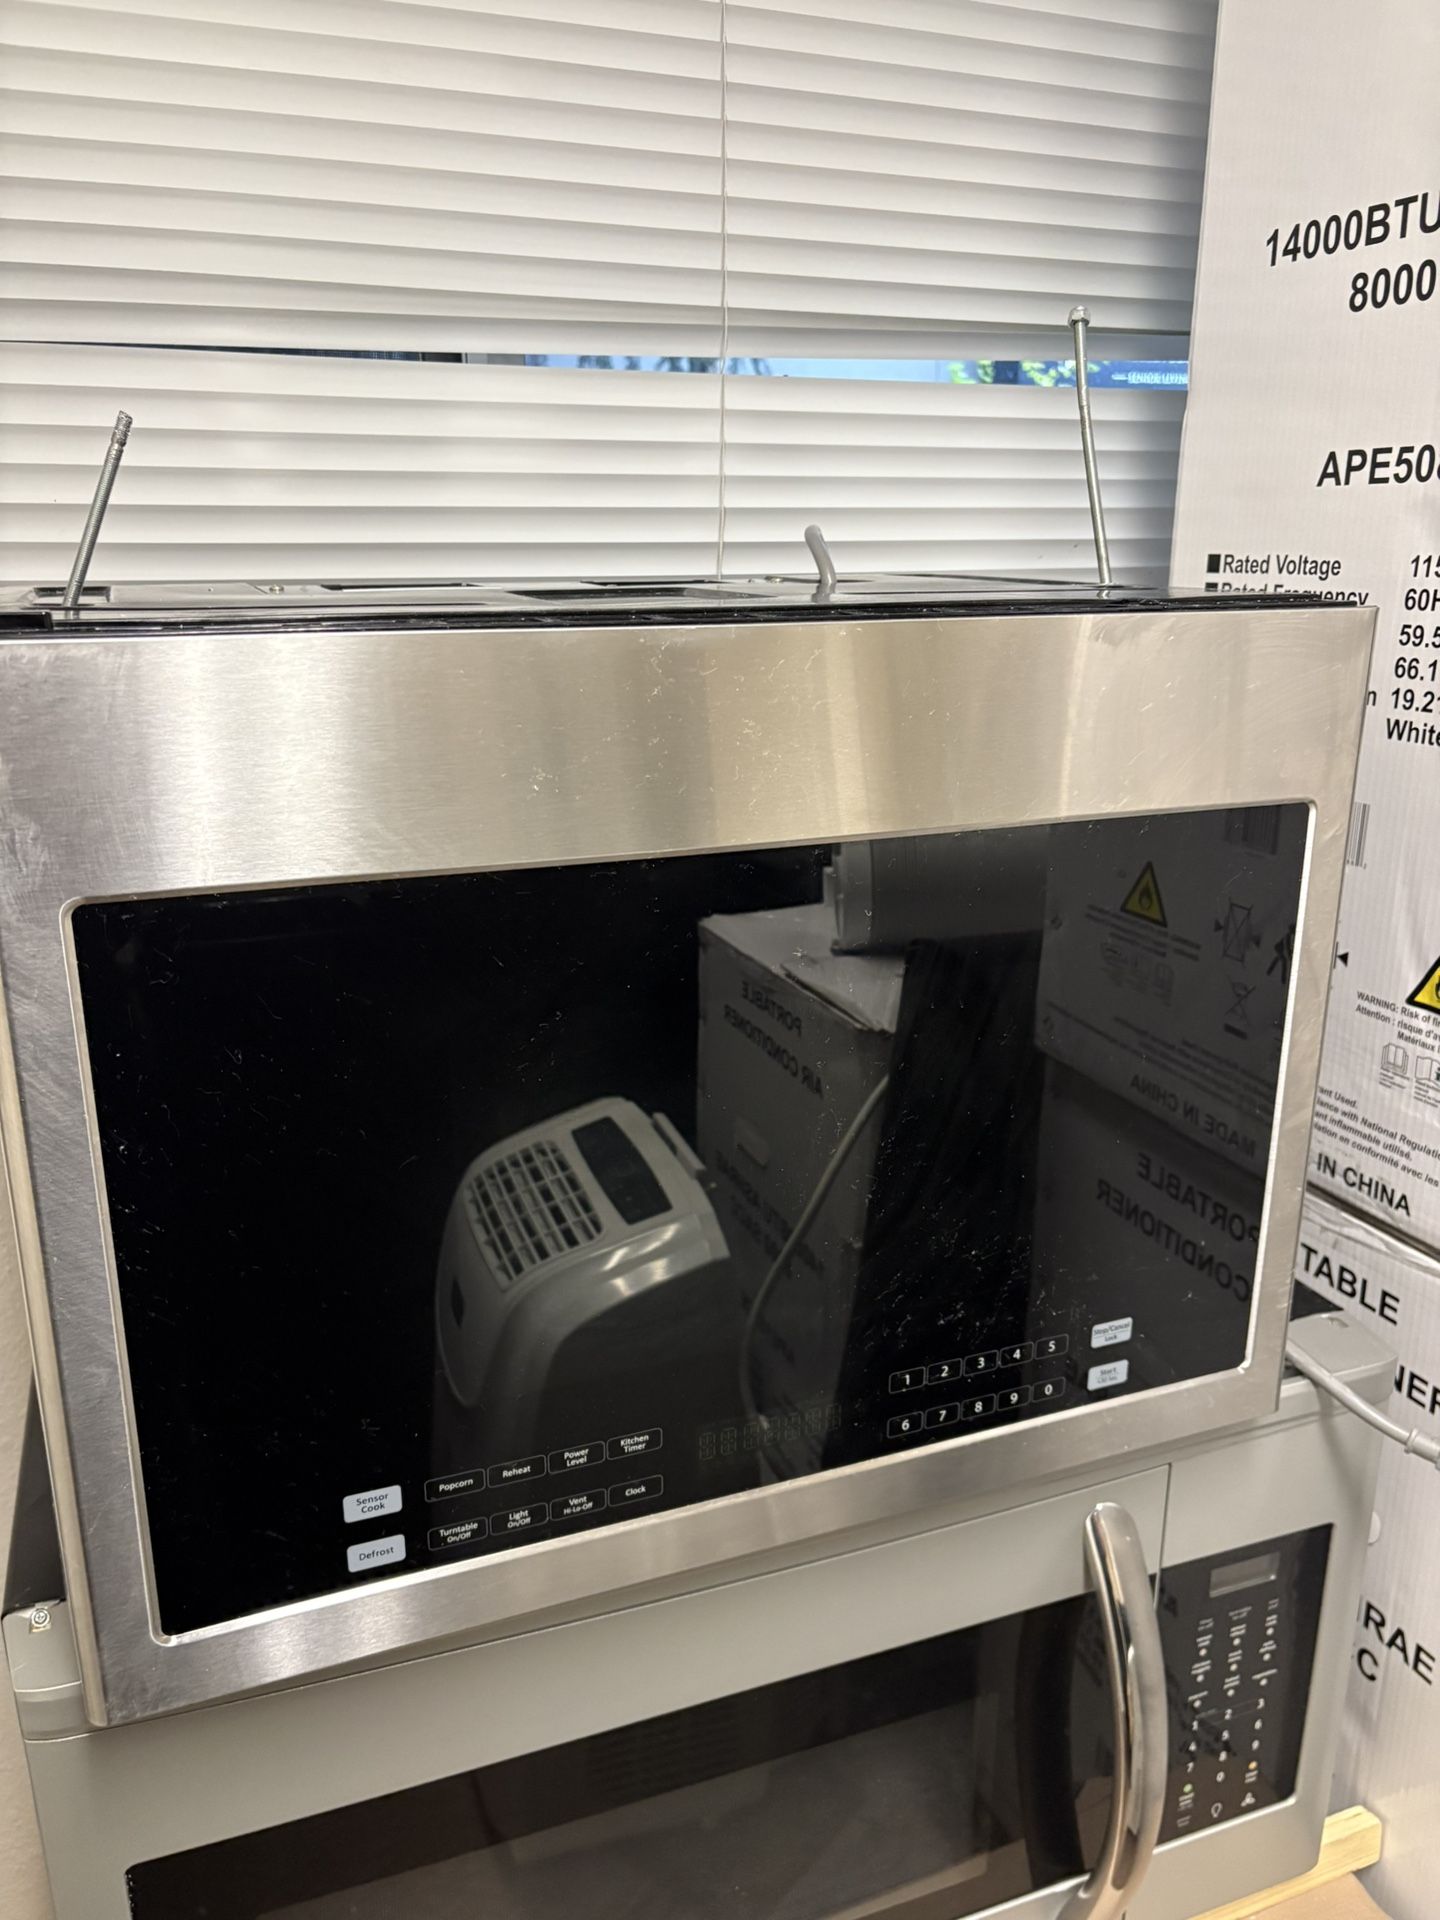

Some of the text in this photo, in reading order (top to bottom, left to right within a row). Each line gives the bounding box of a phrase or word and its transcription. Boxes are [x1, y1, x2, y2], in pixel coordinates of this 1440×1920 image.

[1266, 191, 1440, 267] 14000BTU
[1350, 259, 1436, 312] 8000
[1316, 444, 1440, 487] APE50
[1223, 554, 1342, 581] Rated Voltage
[1394, 656, 1438, 682] 66.1
[1391, 687, 1440, 713] 19.2
[1357, 991, 1399, 1013] WARNING:
[1401, 1006, 1419, 1021] Risk
[1421, 1014, 1431, 1024] of
[1356, 1004, 1391, 1025] Attention
[1397, 1019, 1423, 1036] risque
[1329, 1115, 1381, 1146] inflammable
[1360, 1116, 1398, 1140] National
[1351, 1139, 1399, 1169] conformité
[1400, 1163, 1423, 1180] avec
[1424, 1173, 1440, 1188] les
[1316, 1152, 1412, 1218] IN CHINA
[1300, 1242, 1401, 1327] TABLE
[904, 1340, 1056, 1385] 1 2 3 4 5
[901, 1384, 1053, 1431] 6 7 8 9 0
[620, 1434, 649, 1447] Kitchen
[623, 1443, 647, 1453] Timer
[564, 1448, 589, 1460] Power
[566, 1456, 588, 1467] Level
[502, 1465, 531, 1479] Reheat
[438, 1478, 473, 1493] Popcorn
[625, 1484, 646, 1496] Clock
[356, 1493, 388, 1506] Sensor
[361, 1502, 386, 1514] Cook
[568, 1495, 587, 1506] Vent
[507, 1516, 532, 1528] On/Off
[508, 1509, 529, 1522] Light
[440, 1521, 479, 1537] Turntable
[446, 1531, 472, 1543] On/Off
[359, 1546, 395, 1561] Defrost
[1224, 1708, 1233, 1720] 2
[1257, 1698, 1265, 1709] 3
[1186, 1761, 1194, 1773] 7
